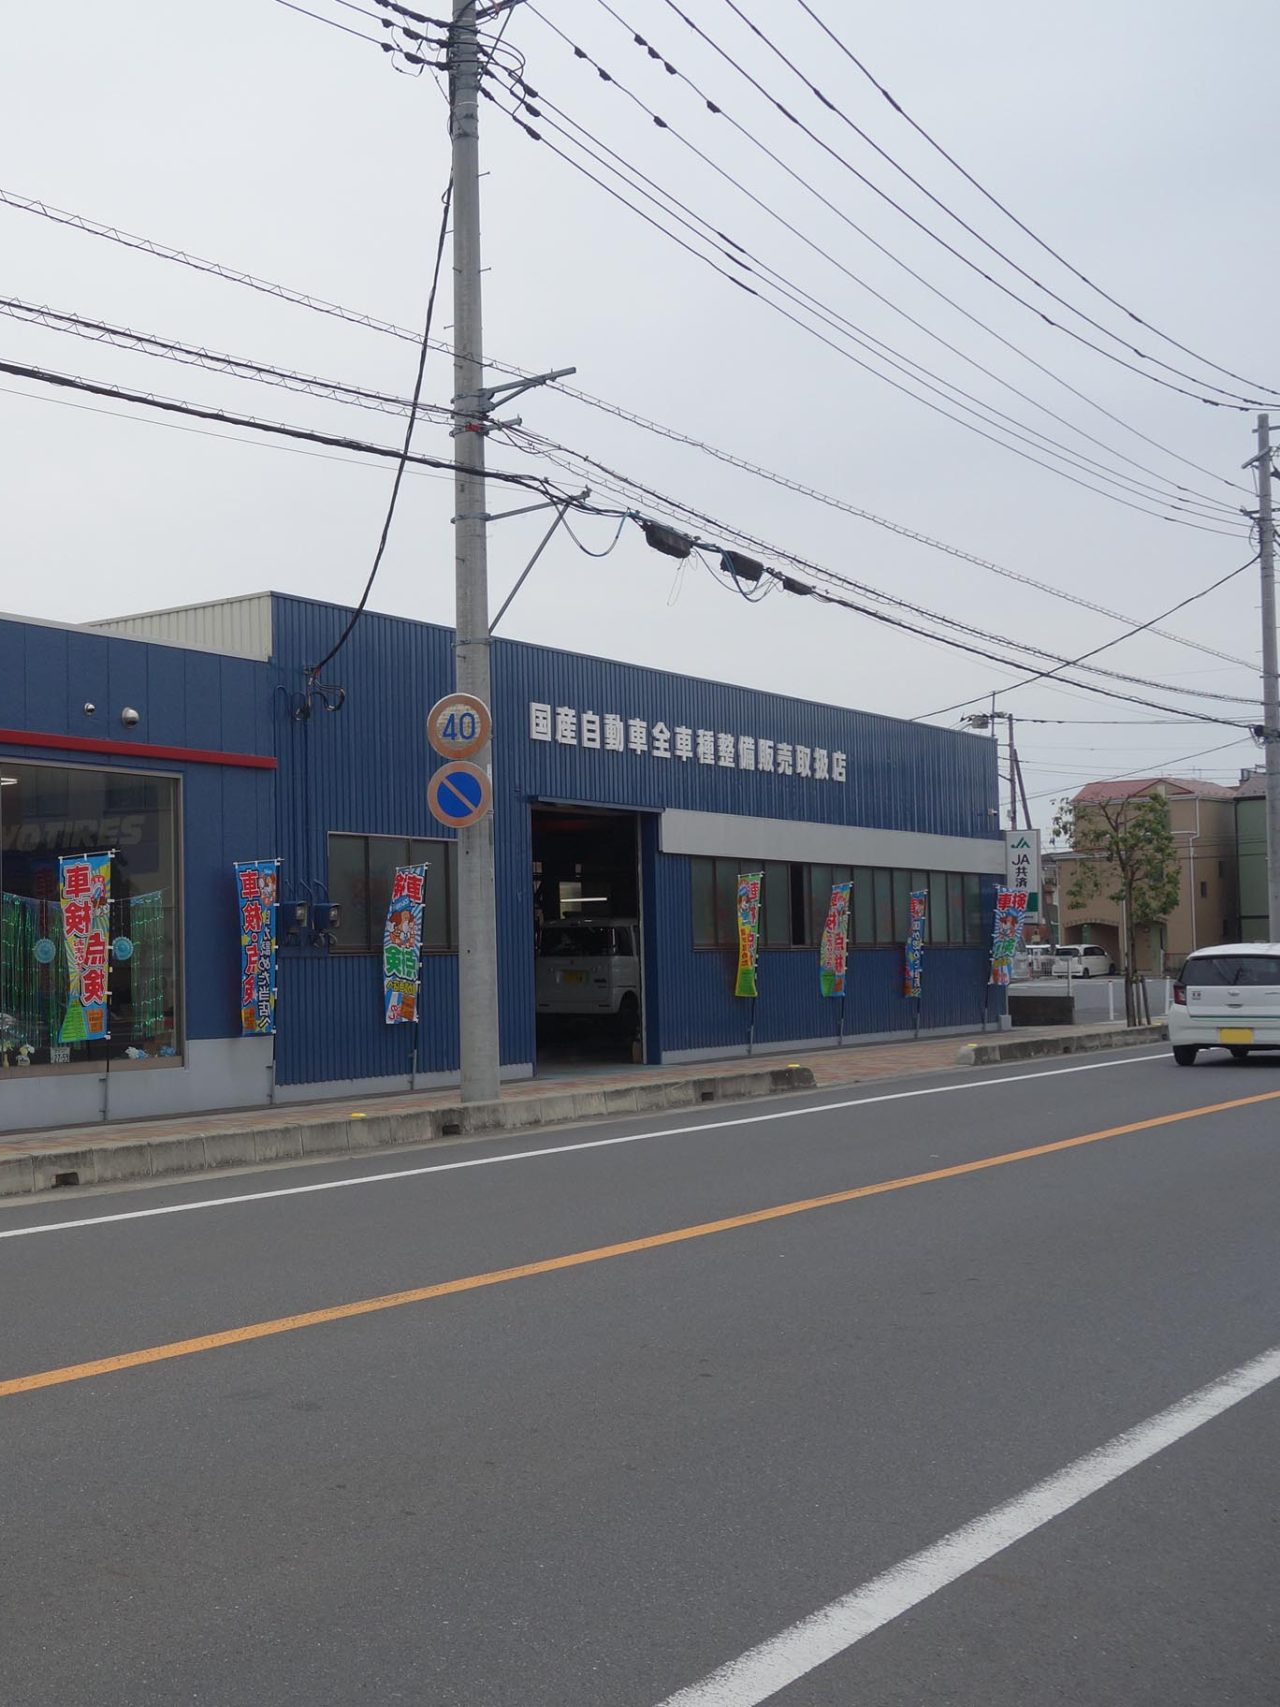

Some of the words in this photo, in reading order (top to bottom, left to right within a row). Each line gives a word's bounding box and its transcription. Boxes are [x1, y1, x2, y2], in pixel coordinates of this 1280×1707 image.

[442, 712, 476, 740] 40
[529, 701, 847, 783] 国産自動車全車種整備販売取扱店
[998, 892, 1027, 912] 車検
